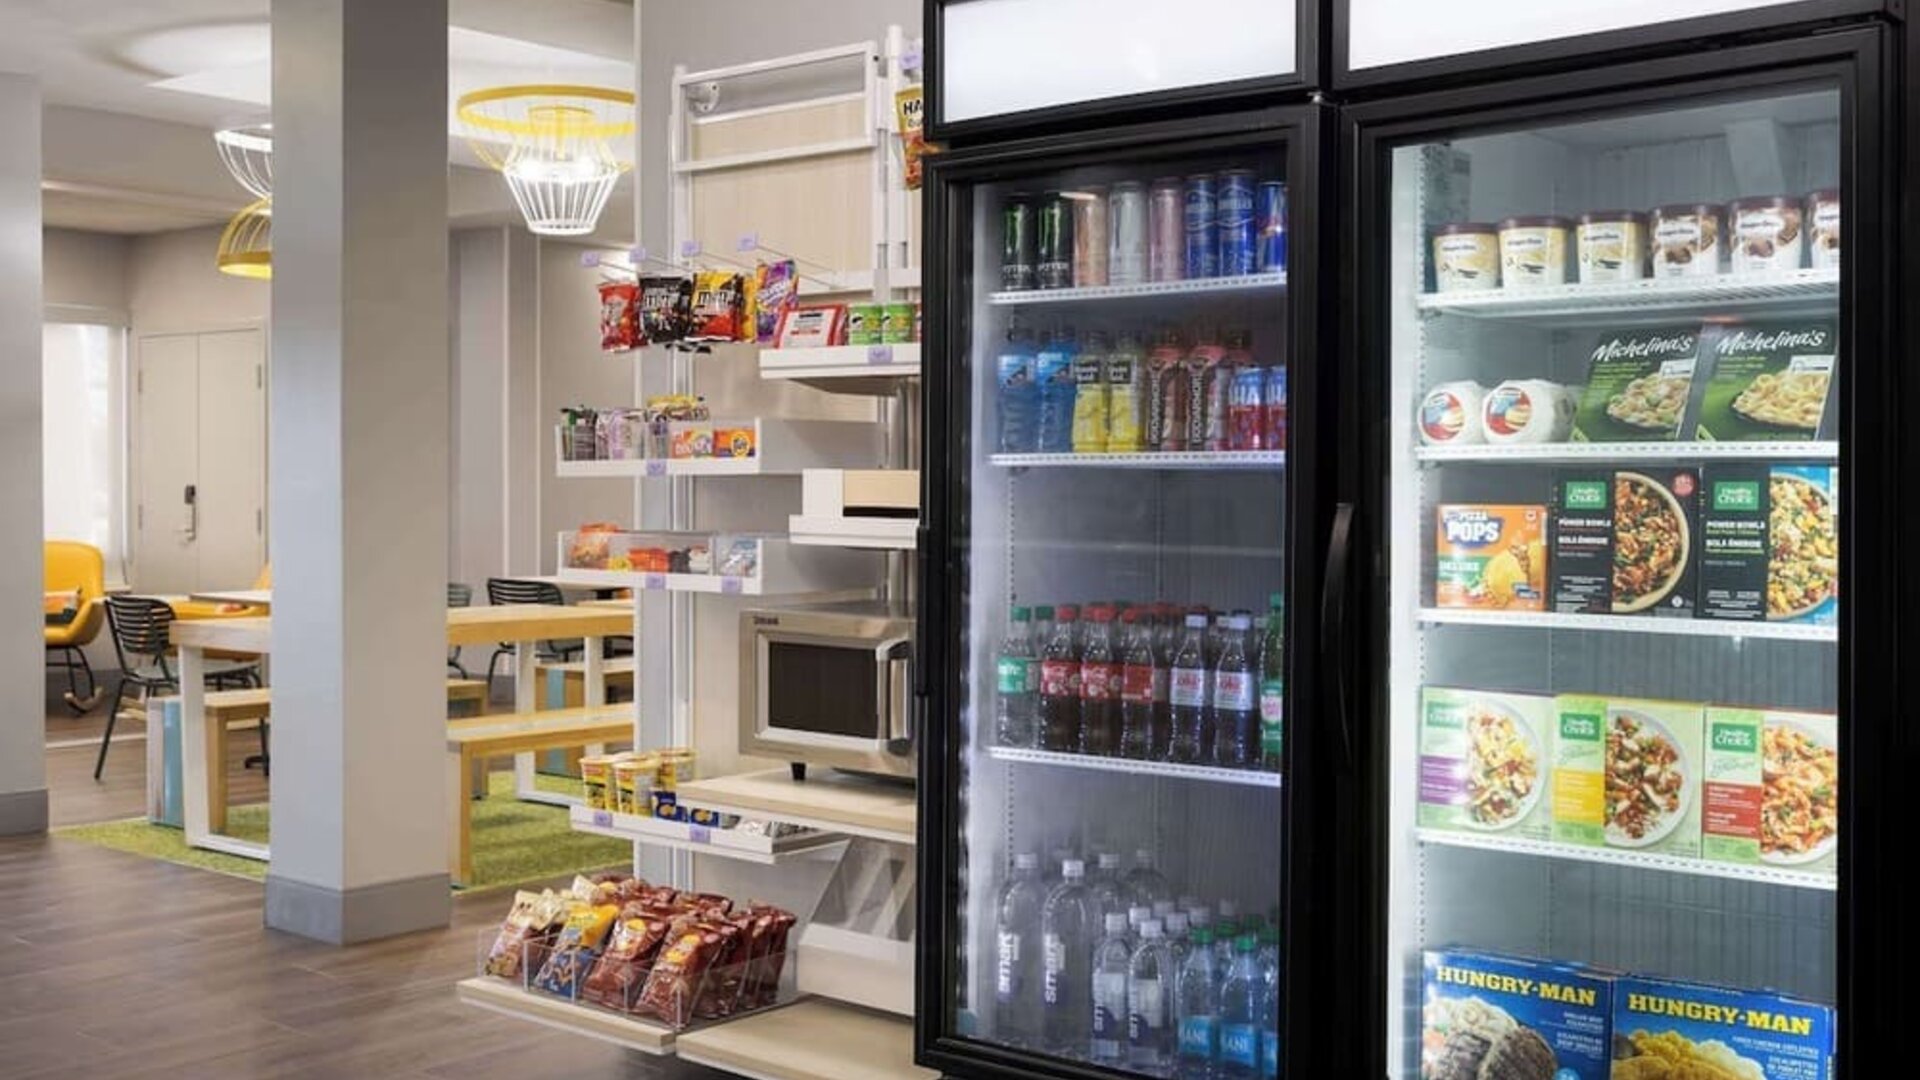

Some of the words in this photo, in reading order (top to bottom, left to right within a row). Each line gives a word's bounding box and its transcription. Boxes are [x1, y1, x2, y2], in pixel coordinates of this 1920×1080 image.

[1591, 335, 1693, 362] Michelina's
[1715, 330, 1826, 355] Michelina's
[1447, 520, 1500, 543] POPS
[1436, 965, 1596, 1007] HUNGRY-MAN
[1628, 993, 1815, 1036] HUNGRY-MAN
